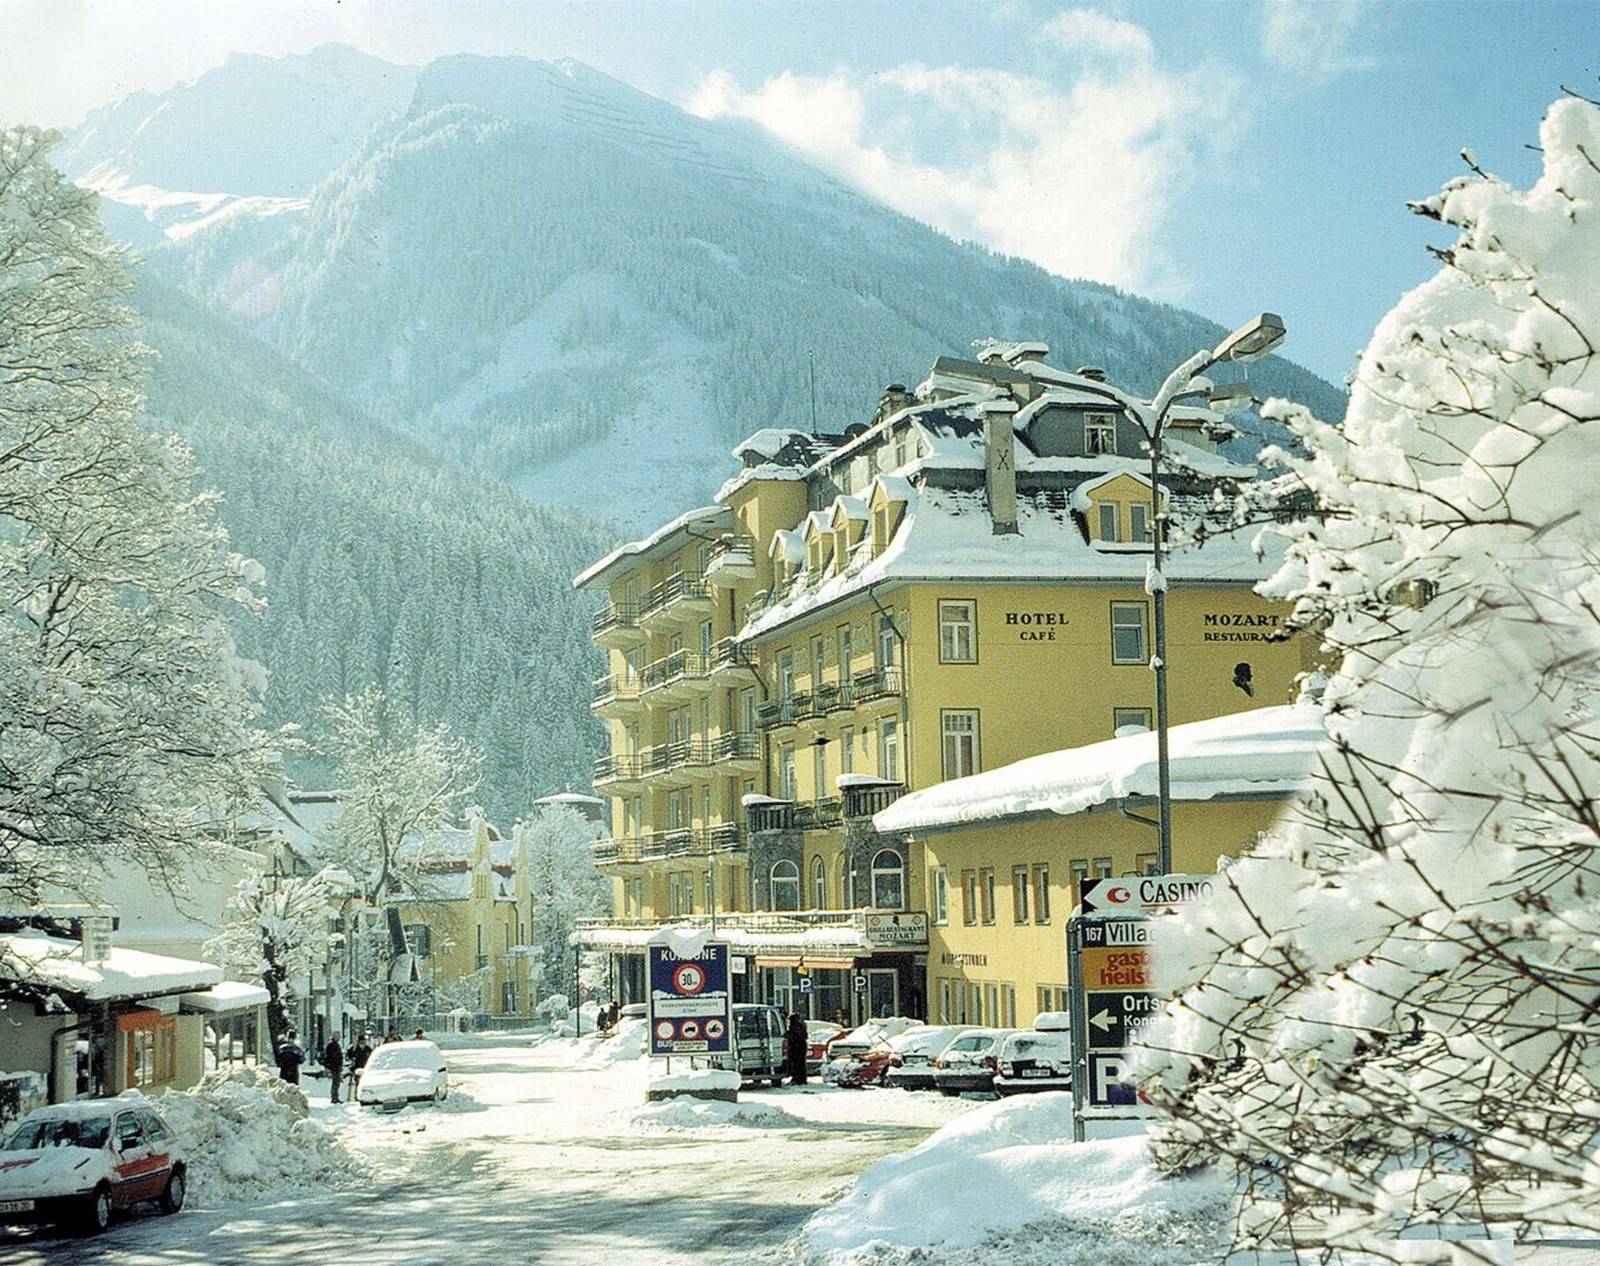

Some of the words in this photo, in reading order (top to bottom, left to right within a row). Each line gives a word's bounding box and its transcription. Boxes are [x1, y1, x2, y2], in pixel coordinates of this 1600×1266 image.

[1005, 612, 1069, 625] HOTEL
[1204, 614, 1280, 626] MOZART
[1019, 627, 1056, 641] CAFÉ
[1204, 632, 1275, 642] RESTAURA
[879, 932, 914, 940] MOZART
[1085, 927, 1103, 942] 167
[661, 949, 717, 961] KUONE
[681, 973, 693, 986] 30
[800, 978, 812, 993] P
[855, 976, 866, 992] P
[657, 1040, 673, 1048] BUS
[1096, 1057, 1126, 1102] P
